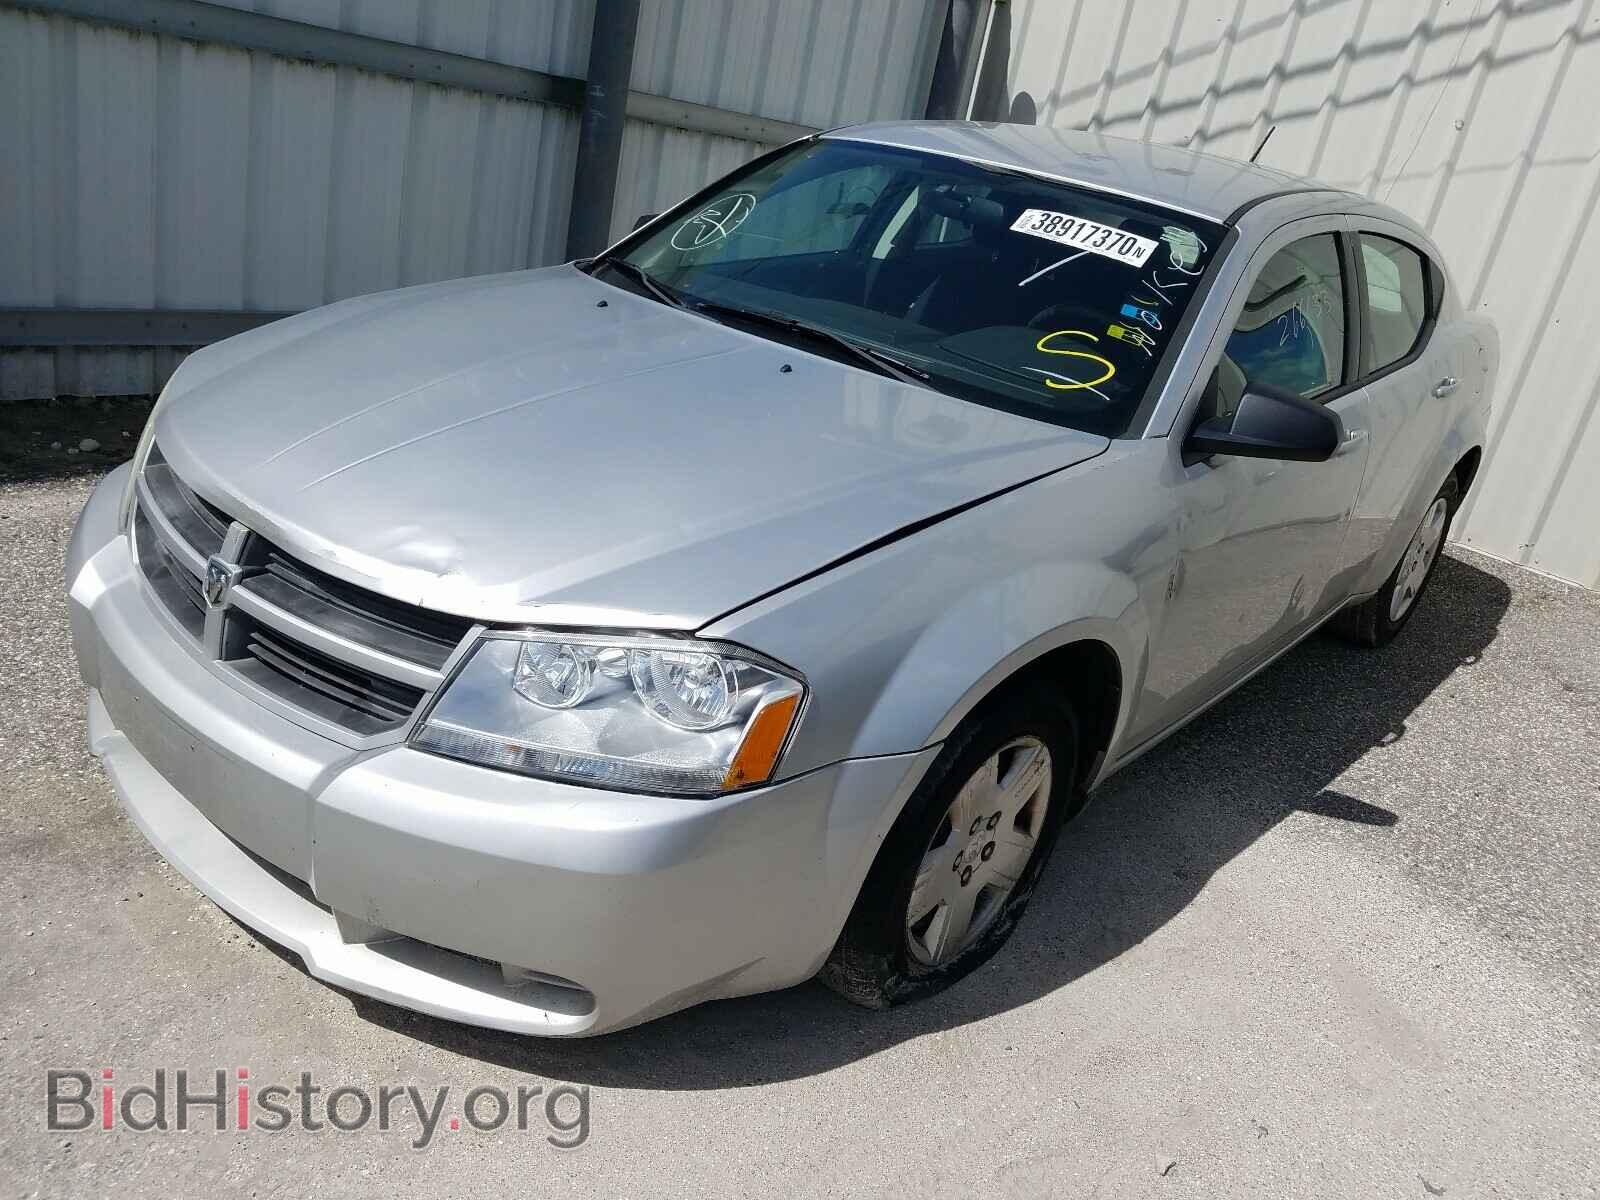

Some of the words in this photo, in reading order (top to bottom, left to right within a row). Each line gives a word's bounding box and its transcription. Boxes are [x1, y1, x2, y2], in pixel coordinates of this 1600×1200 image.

[1031, 212, 1138, 256] 38917370
[1132, 247, 1146, 259] N
[1036, 330, 1116, 390] S
